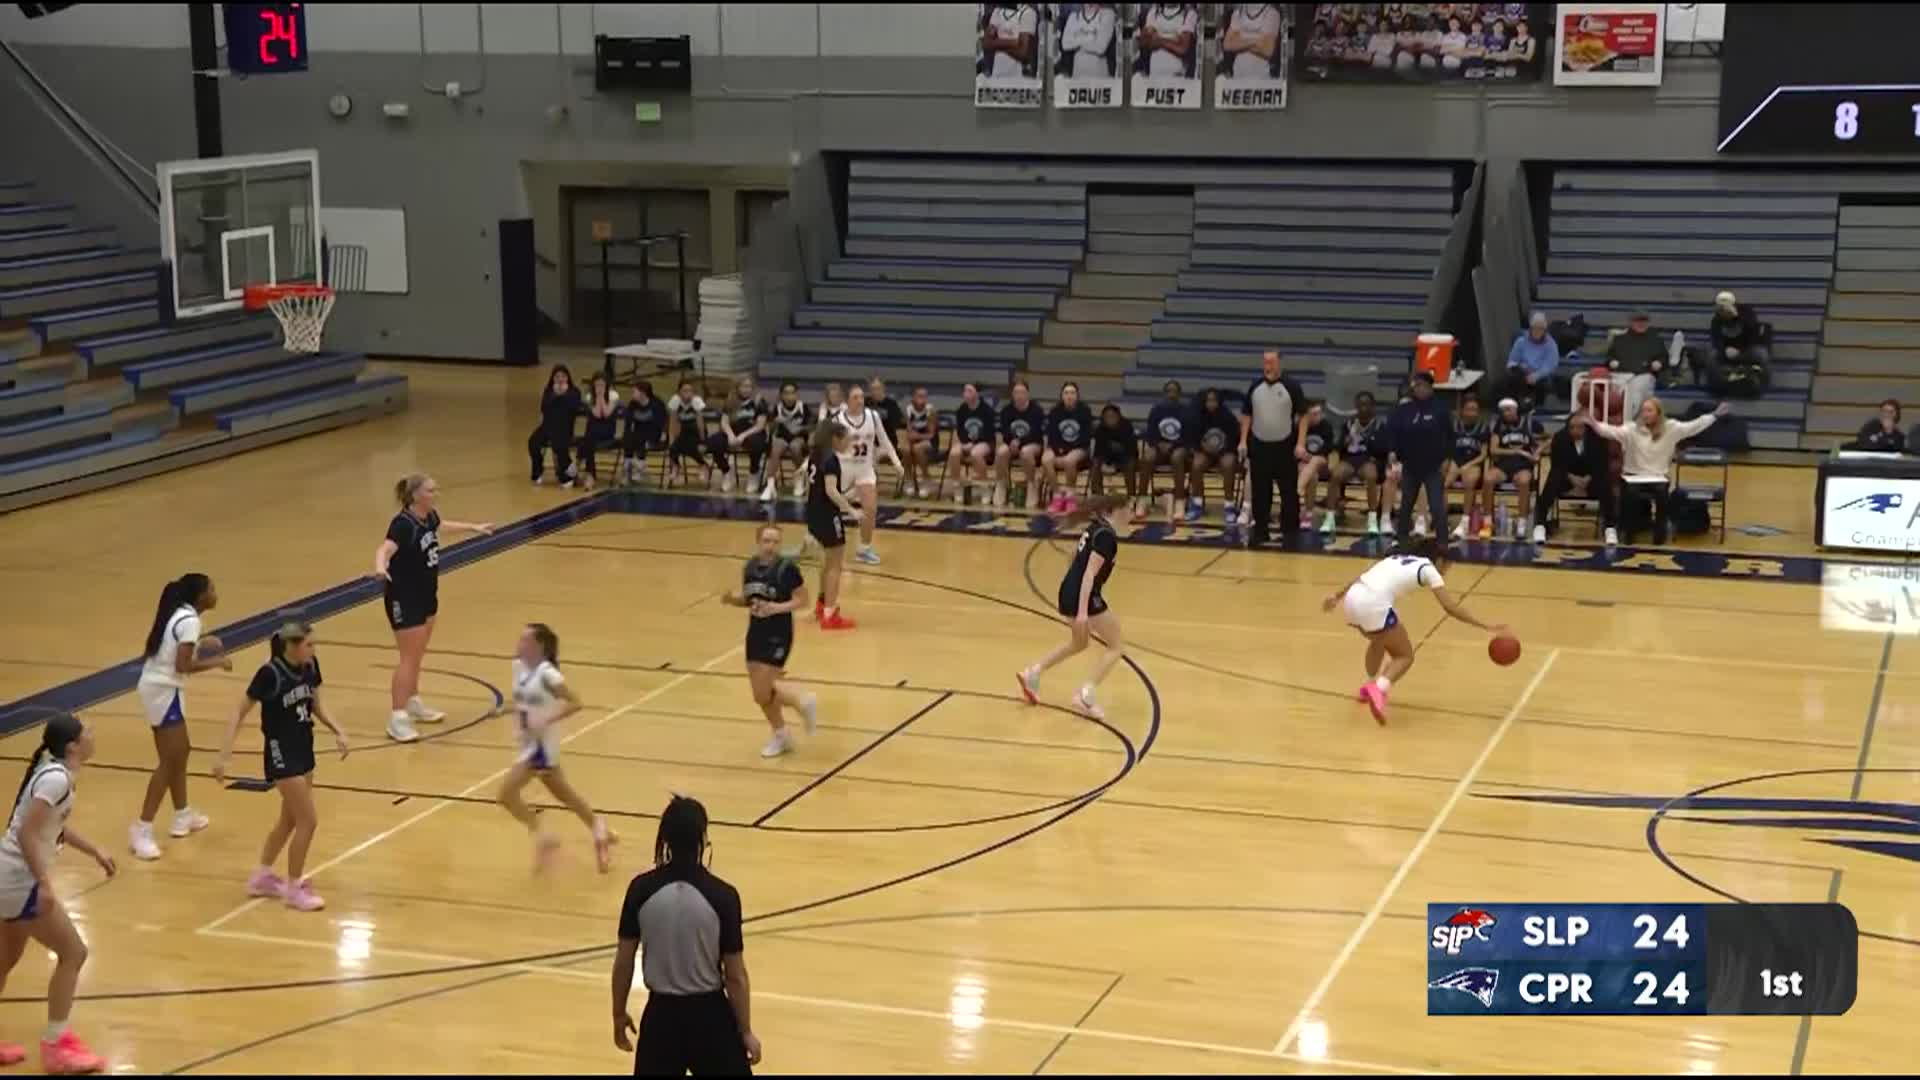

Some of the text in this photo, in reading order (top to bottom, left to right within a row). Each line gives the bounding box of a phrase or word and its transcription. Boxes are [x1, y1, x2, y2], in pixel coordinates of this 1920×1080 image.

[260, 11, 297, 64] 24
[1068, 87, 1112, 104] DAVIS
[1145, 88, 1185, 104] PUST
[1834, 102, 1859, 140] 8
